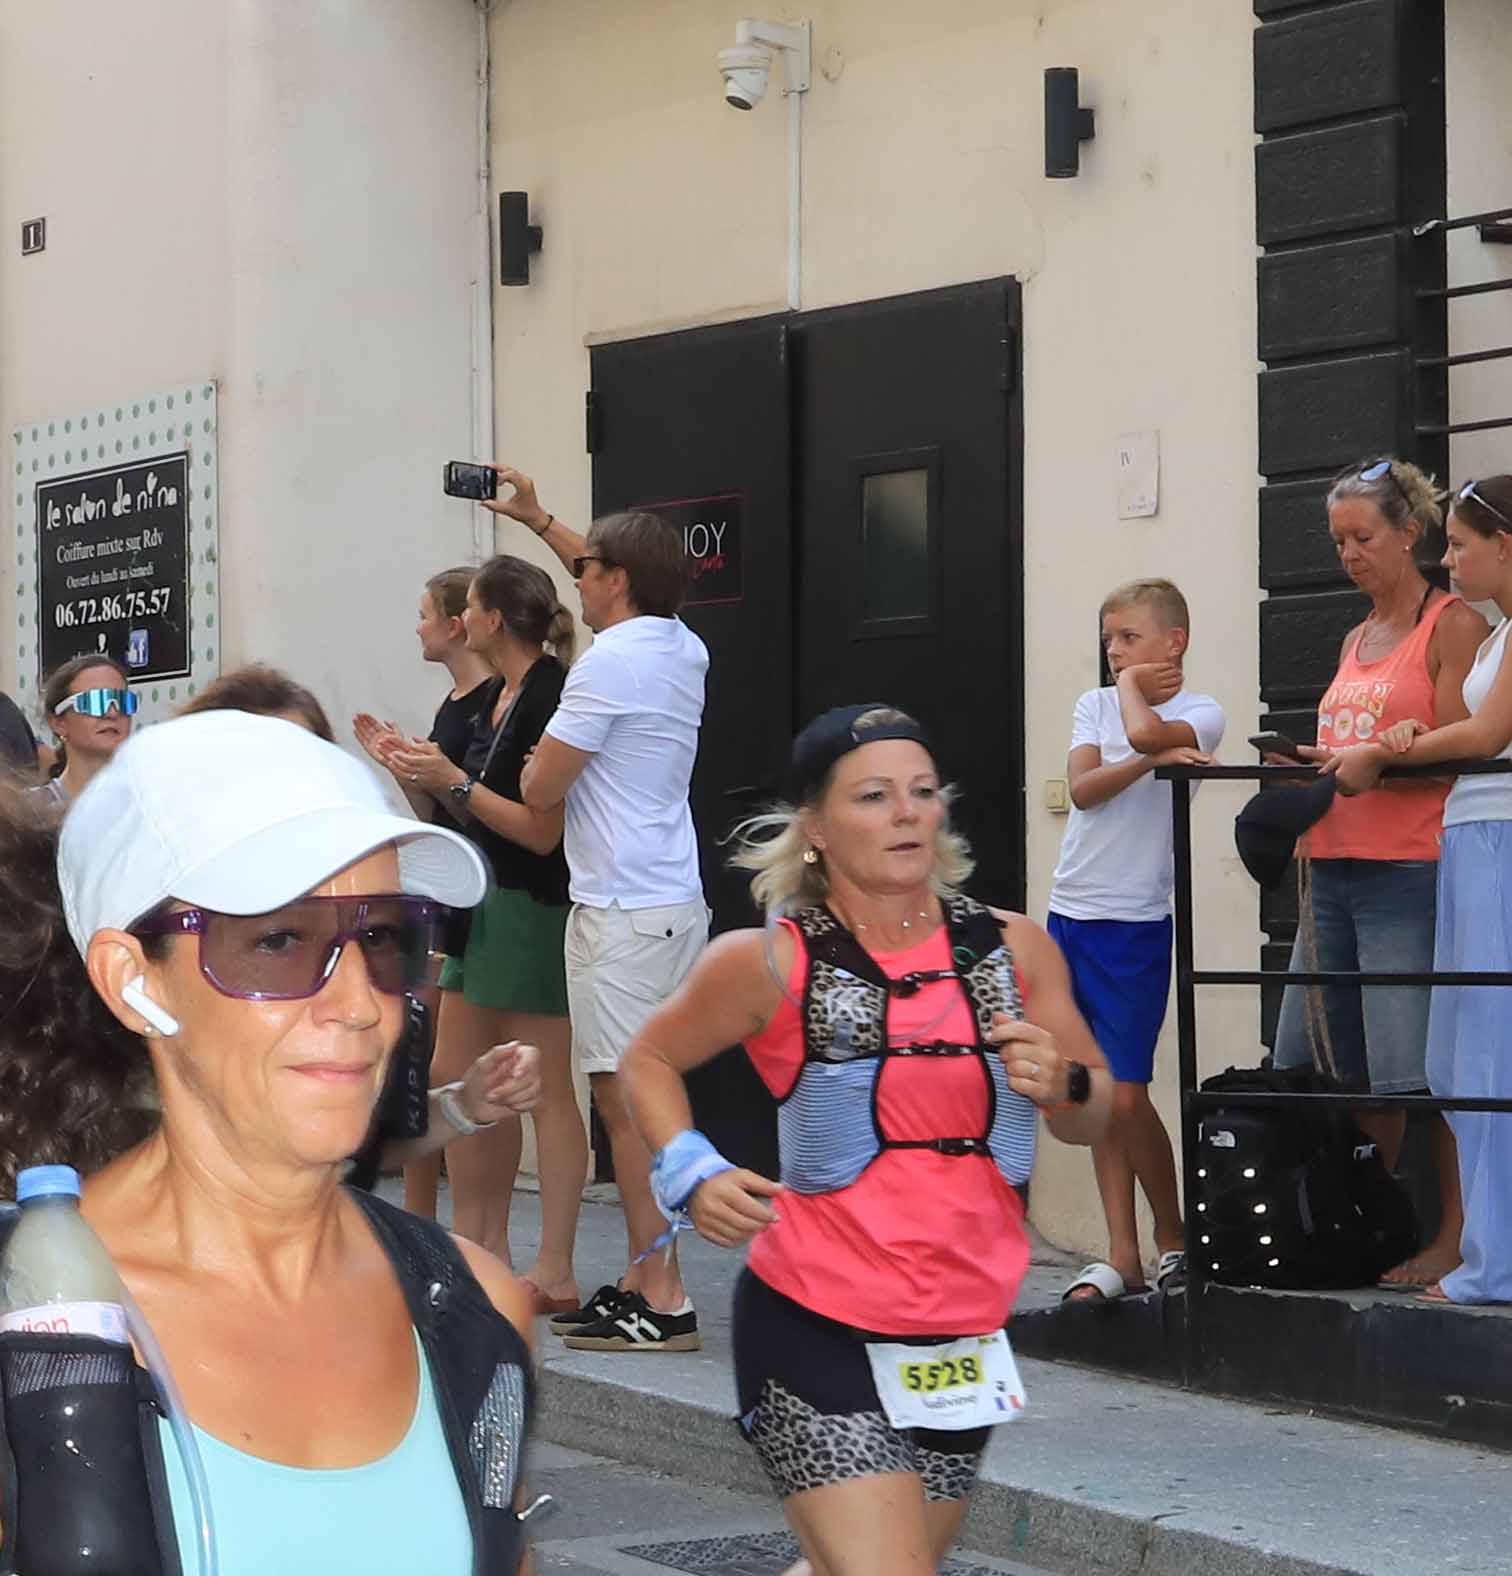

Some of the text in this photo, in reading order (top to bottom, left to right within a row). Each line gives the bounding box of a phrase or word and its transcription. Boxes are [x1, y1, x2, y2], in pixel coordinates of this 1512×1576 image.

[46, 500, 61, 531] le
[112, 478, 132, 517] de
[137, 472, 178, 512] nina
[56, 541, 96, 564] Coiffure
[96, 536, 124, 557] mixte
[143, 528, 164, 548] Rdv
[55, 587, 171, 628] 06.72.86.75.57
[907, 1357, 977, 1390] 5528
